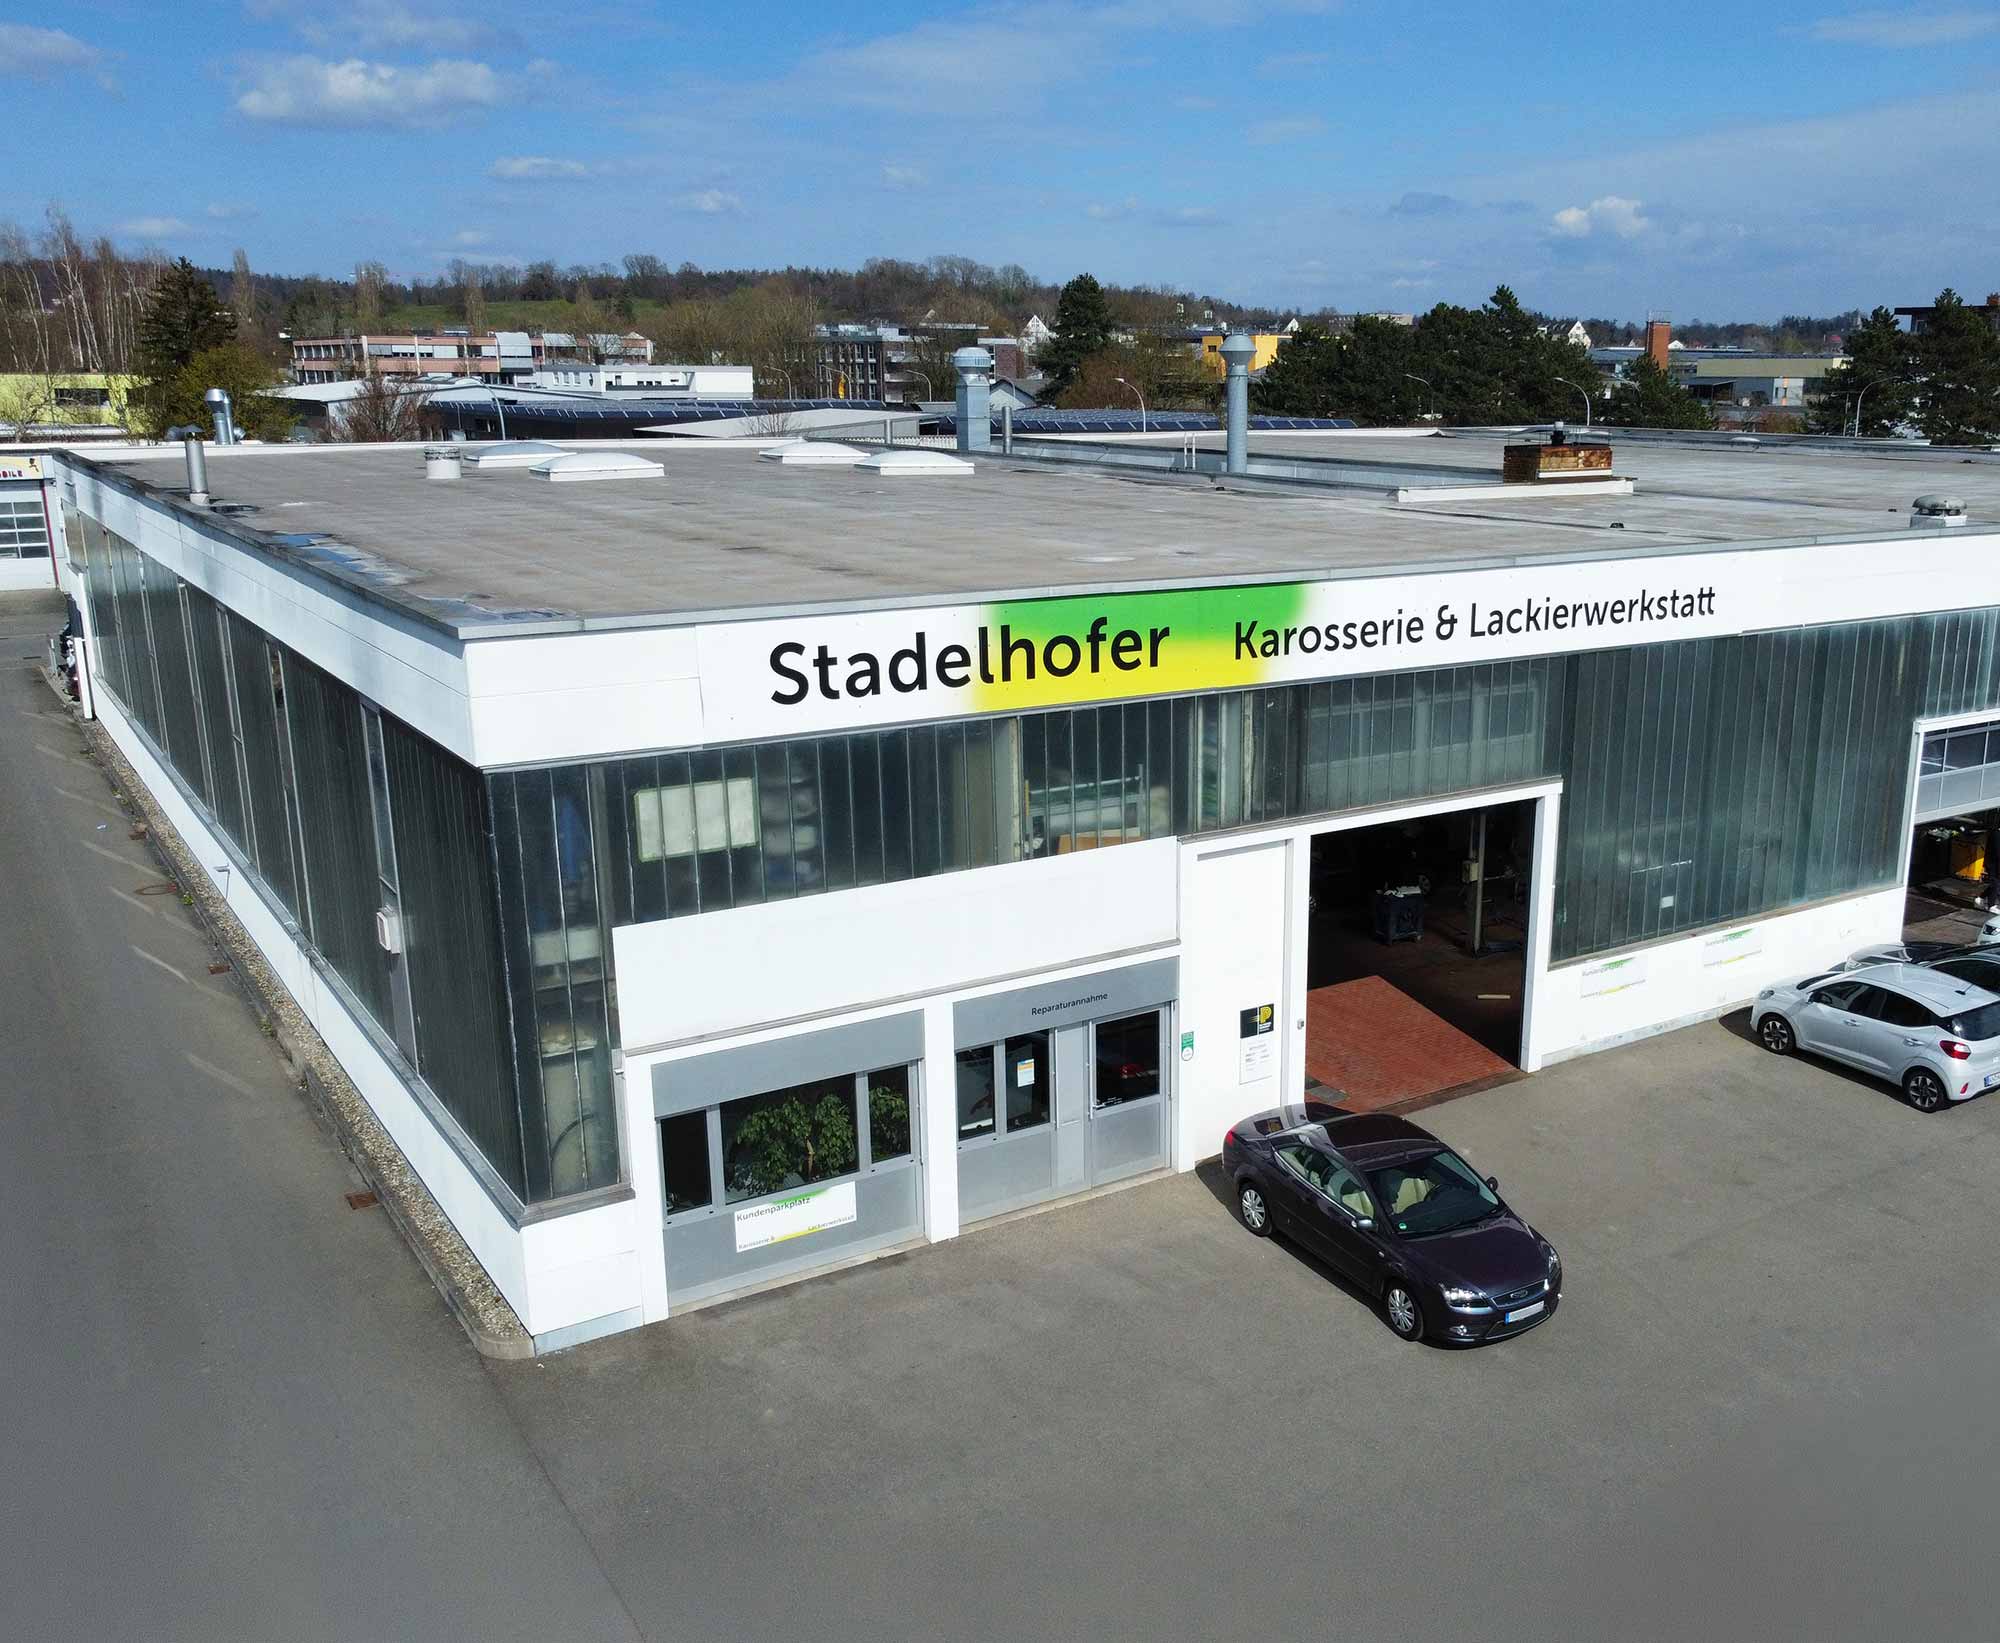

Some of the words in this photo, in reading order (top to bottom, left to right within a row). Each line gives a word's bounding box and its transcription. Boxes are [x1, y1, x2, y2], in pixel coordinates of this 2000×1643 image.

[1234, 606, 1424, 660] Karosserie
[1436, 604, 1459, 641] &
[1471, 586, 1717, 638] Lackierwerkstatt
[769, 616, 1170, 705] Stadelhofer
[1031, 992, 1108, 1016] Reparaturannahme
[736, 1196, 811, 1222] Kundenparkplatz
